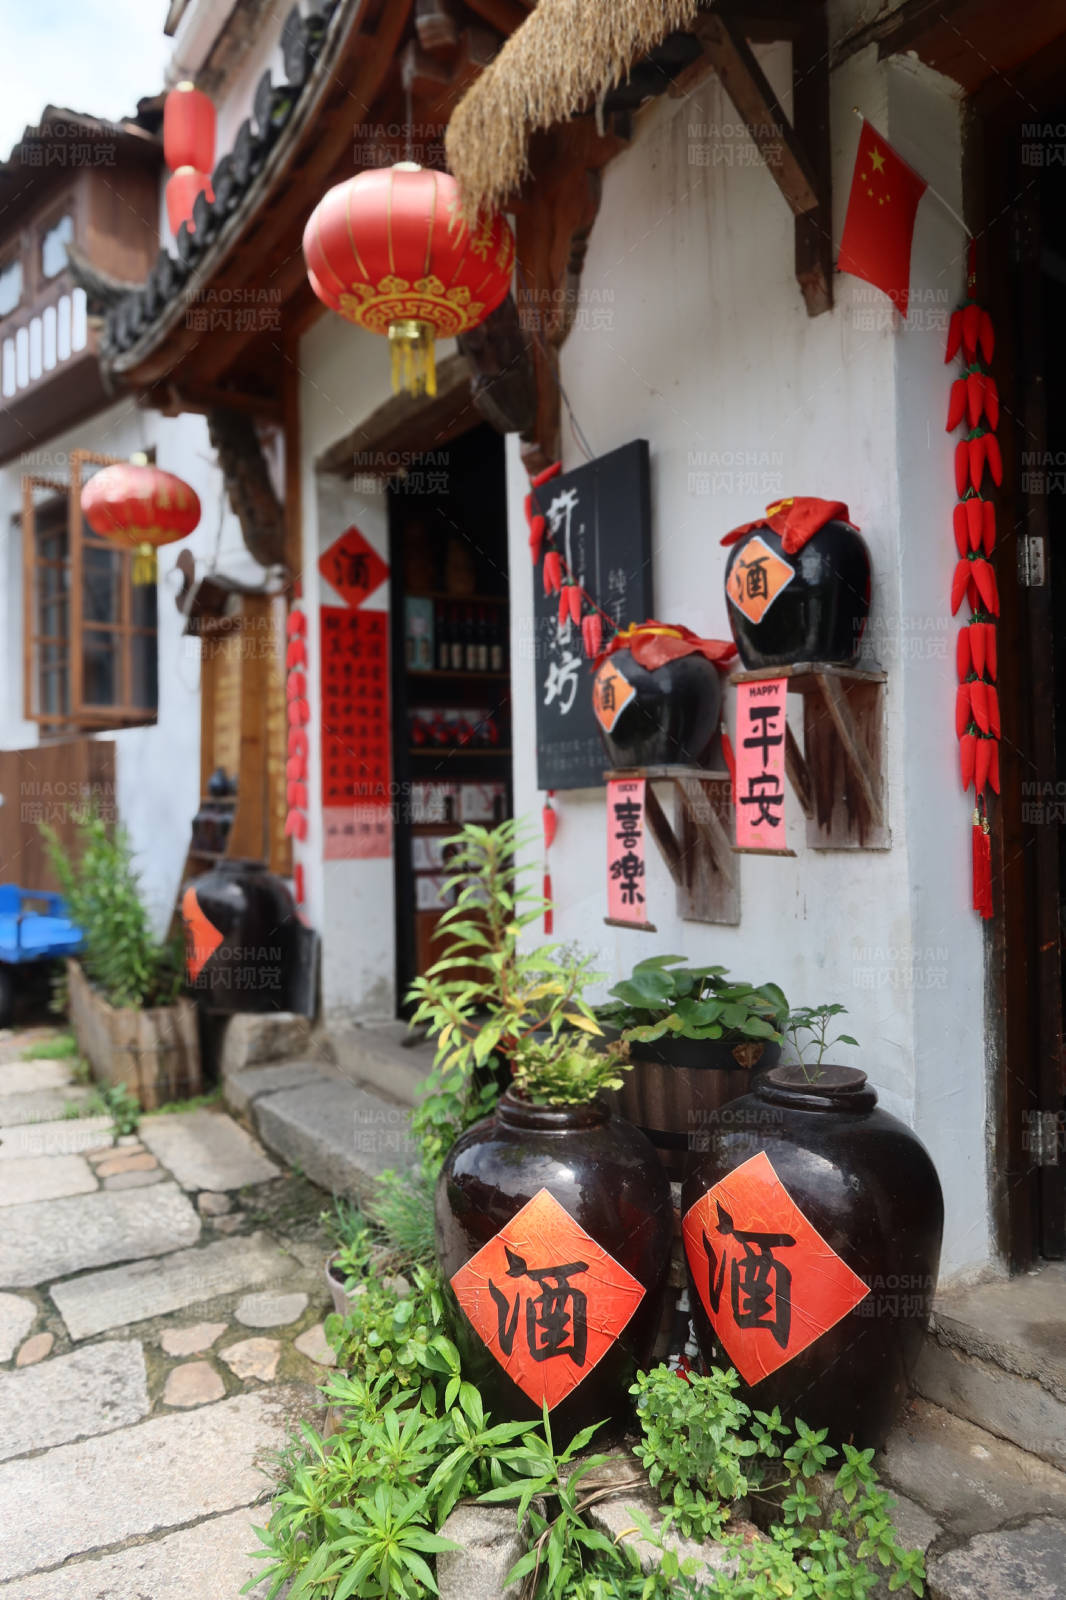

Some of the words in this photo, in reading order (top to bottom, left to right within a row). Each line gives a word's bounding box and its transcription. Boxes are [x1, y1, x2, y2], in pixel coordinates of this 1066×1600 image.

[333, 547, 371, 590] 酒
[735, 556, 770, 603] 酒
[749, 684, 779, 697] HAPPY
[740, 705, 785, 828] 平安
[489, 1245, 590, 1368] 酒
[702, 1199, 797, 1350] 酒
